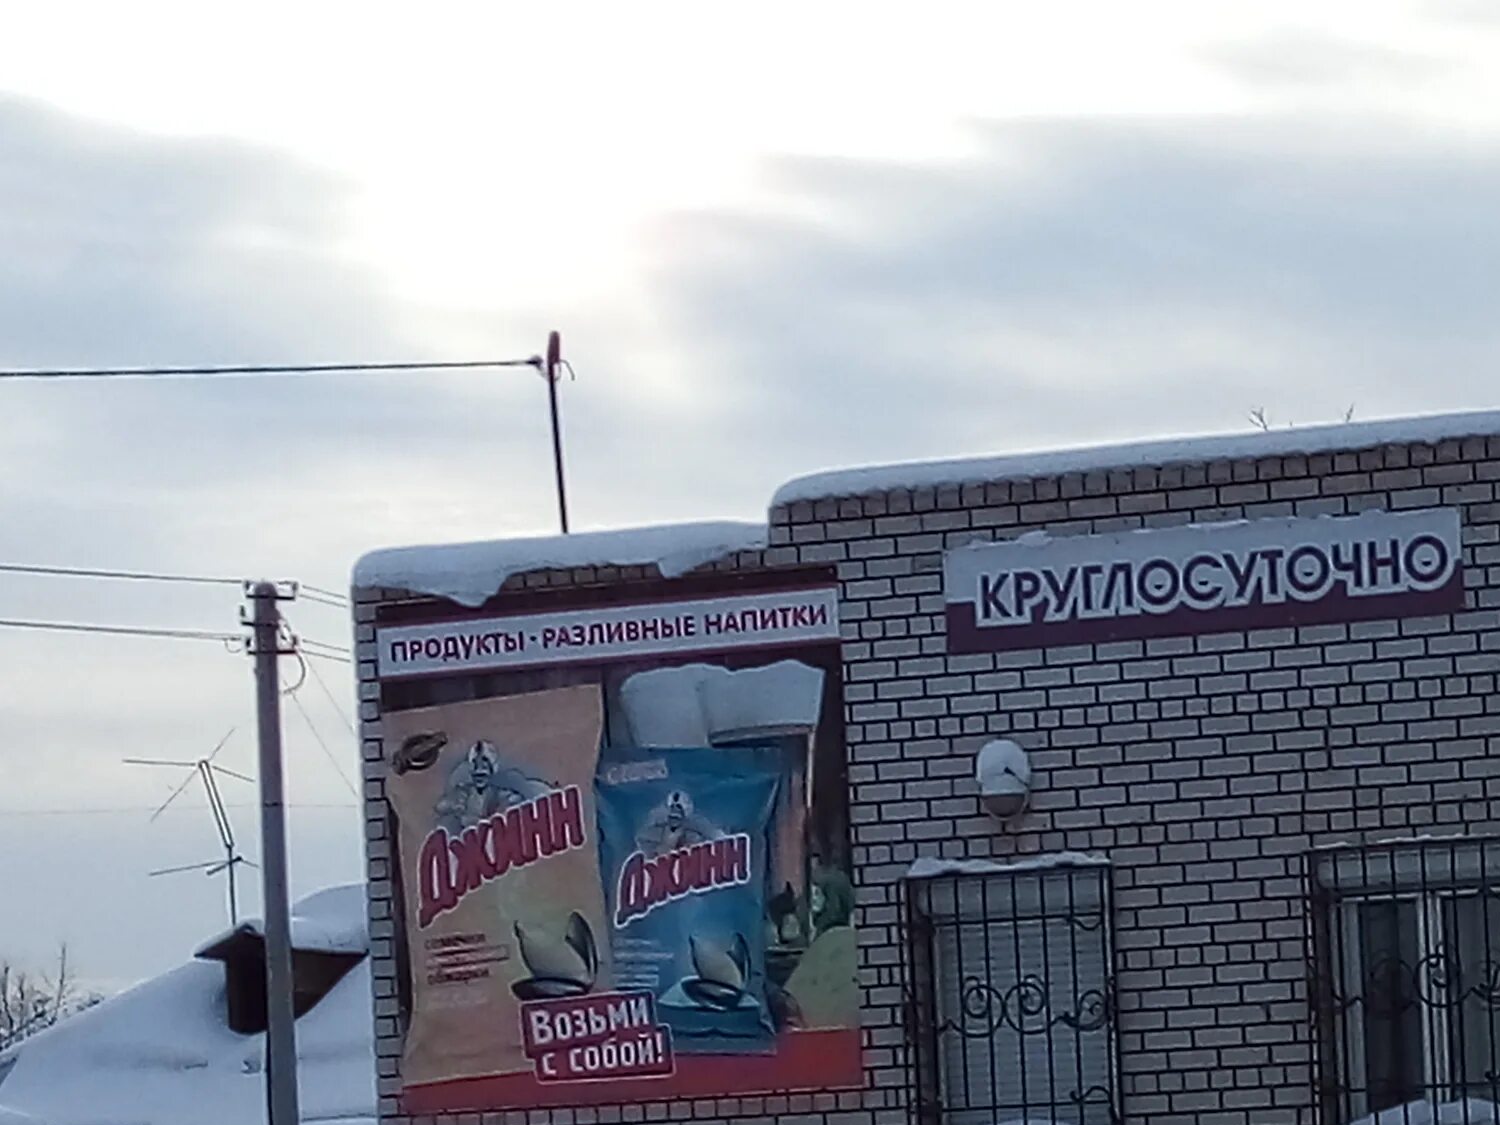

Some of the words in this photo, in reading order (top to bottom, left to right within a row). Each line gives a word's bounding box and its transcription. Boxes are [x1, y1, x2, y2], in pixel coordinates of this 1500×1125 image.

[980, 534, 1449, 620] КРУГЛОСУТОЧНО
[390, 630, 525, 663] ПРОДУКТЫ
[541, 615, 696, 649] РАЗЛИВНЫЕ
[704, 603, 828, 635] НАПИТКИ
[541, 1051, 557, 1076] с
[569, 1033, 665, 1072] собой!
